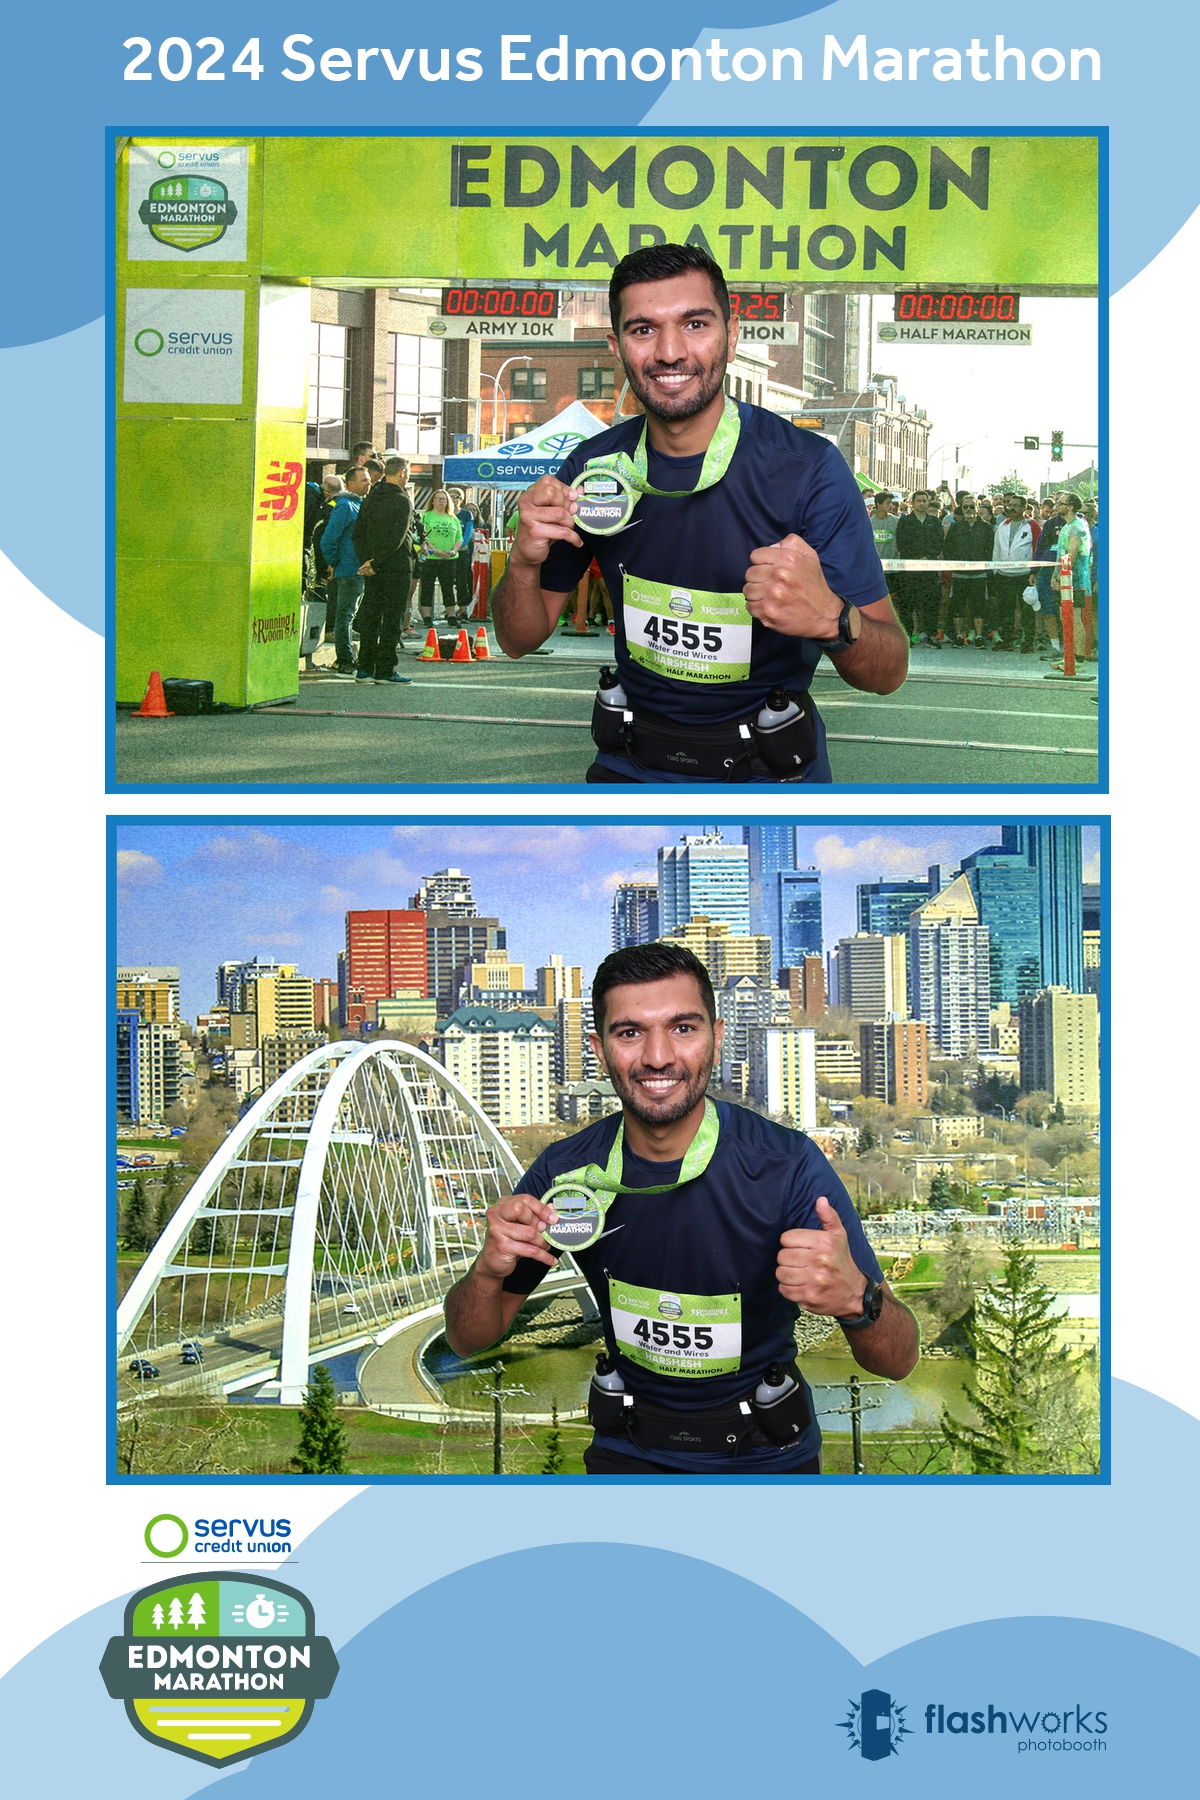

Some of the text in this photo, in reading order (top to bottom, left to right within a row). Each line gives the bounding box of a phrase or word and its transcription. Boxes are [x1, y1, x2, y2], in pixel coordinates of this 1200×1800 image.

[178, 152, 220, 161] servus
[450, 144, 991, 211] EDMONTON
[149, 203, 227, 214] EDMONTON
[160, 214, 215, 222] MARATHON
[465, 321, 554, 336] ARMY 10K
[900, 327, 1031, 341] HALF MARATHON
[168, 331, 233, 345] servus
[168, 345, 233, 355] credit union
[496, 465, 545, 475] servus
[579, 509, 621, 518] MARATHON
[257, 613, 291, 635] Running
[643, 616, 723, 653] 4555
[648, 640, 718, 661] Water and Wires
[653, 653, 710, 672] HARSHESH
[666, 667, 731, 680] HALF MARATHON
[549, 1224, 593, 1234] MARATHON
[633, 1318, 714, 1350] 4555
[638, 1340, 710, 1358] Water and Wires
[645, 1351, 702, 1368] HARSHESH
[659, 1365, 723, 1375] HALF MARATHON
